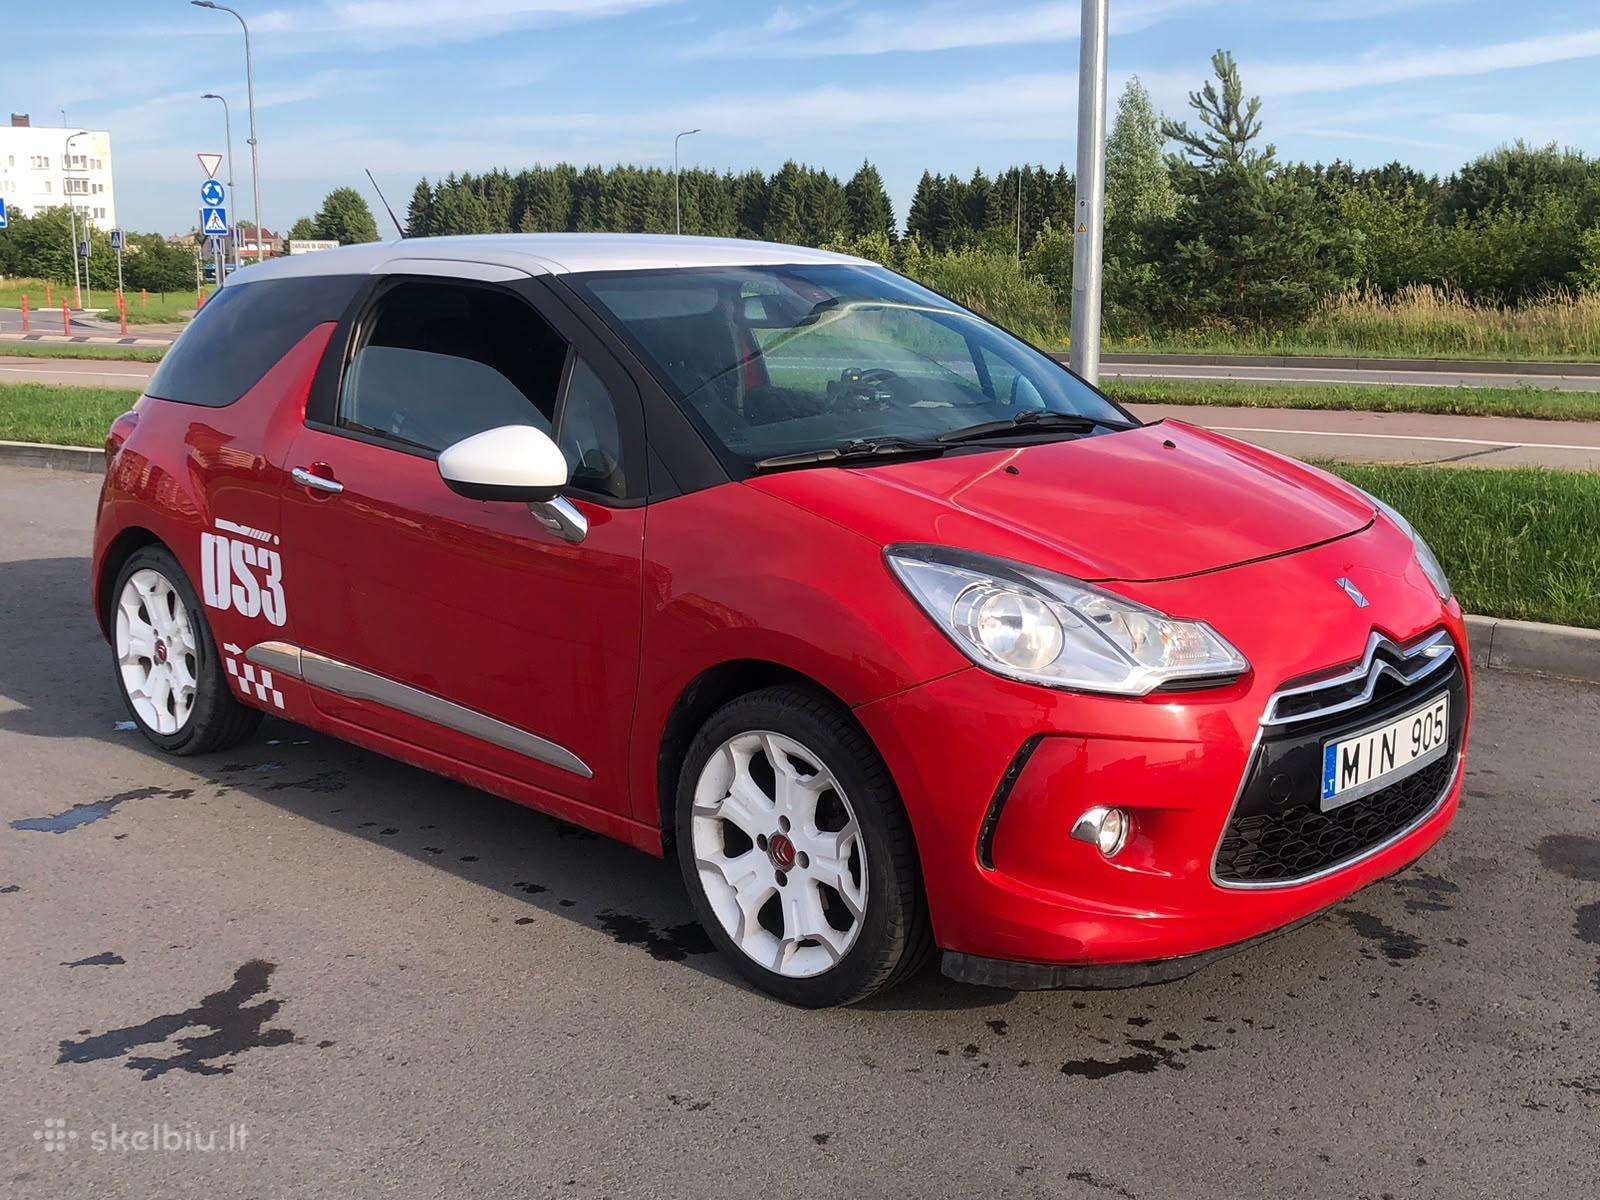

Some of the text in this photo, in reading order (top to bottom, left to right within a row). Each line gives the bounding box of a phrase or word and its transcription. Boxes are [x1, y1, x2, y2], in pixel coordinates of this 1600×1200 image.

[201, 532, 287, 627] DS3
[1323, 779, 1334, 793] LT
[1341, 704, 1444, 790] MIN 905
